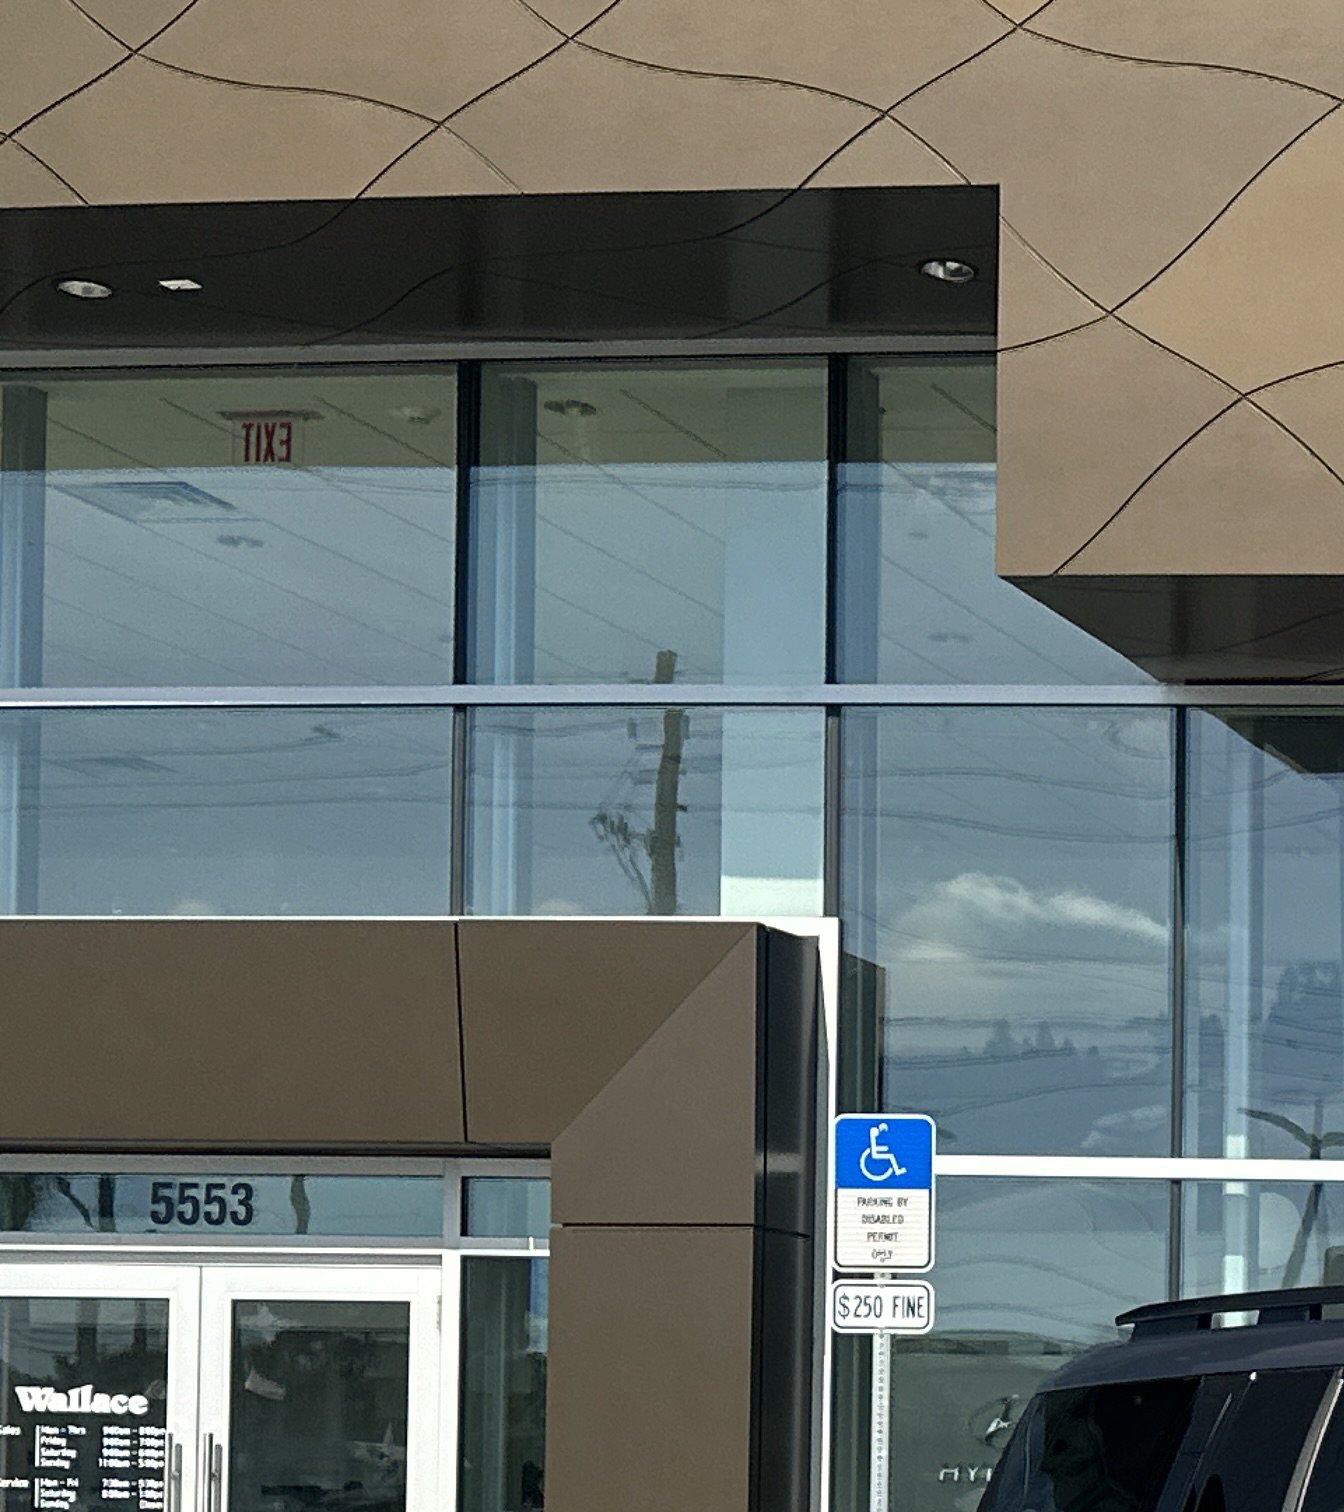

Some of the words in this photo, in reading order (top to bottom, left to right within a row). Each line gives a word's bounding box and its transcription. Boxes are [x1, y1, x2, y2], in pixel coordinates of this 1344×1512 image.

[150, 1182, 254, 1226] 5553
[857, 1196, 894, 1208] PARKING
[897, 1197, 909, 1208] BY
[861, 1213, 905, 1225] DISABLED
[867, 1231, 899, 1242] PERMIT
[871, 1249, 894, 1260] ONLY
[838, 1293, 883, 1320] $250
[892, 1295, 926, 1319] FINE
[14, 1384, 149, 1415] Wallace
